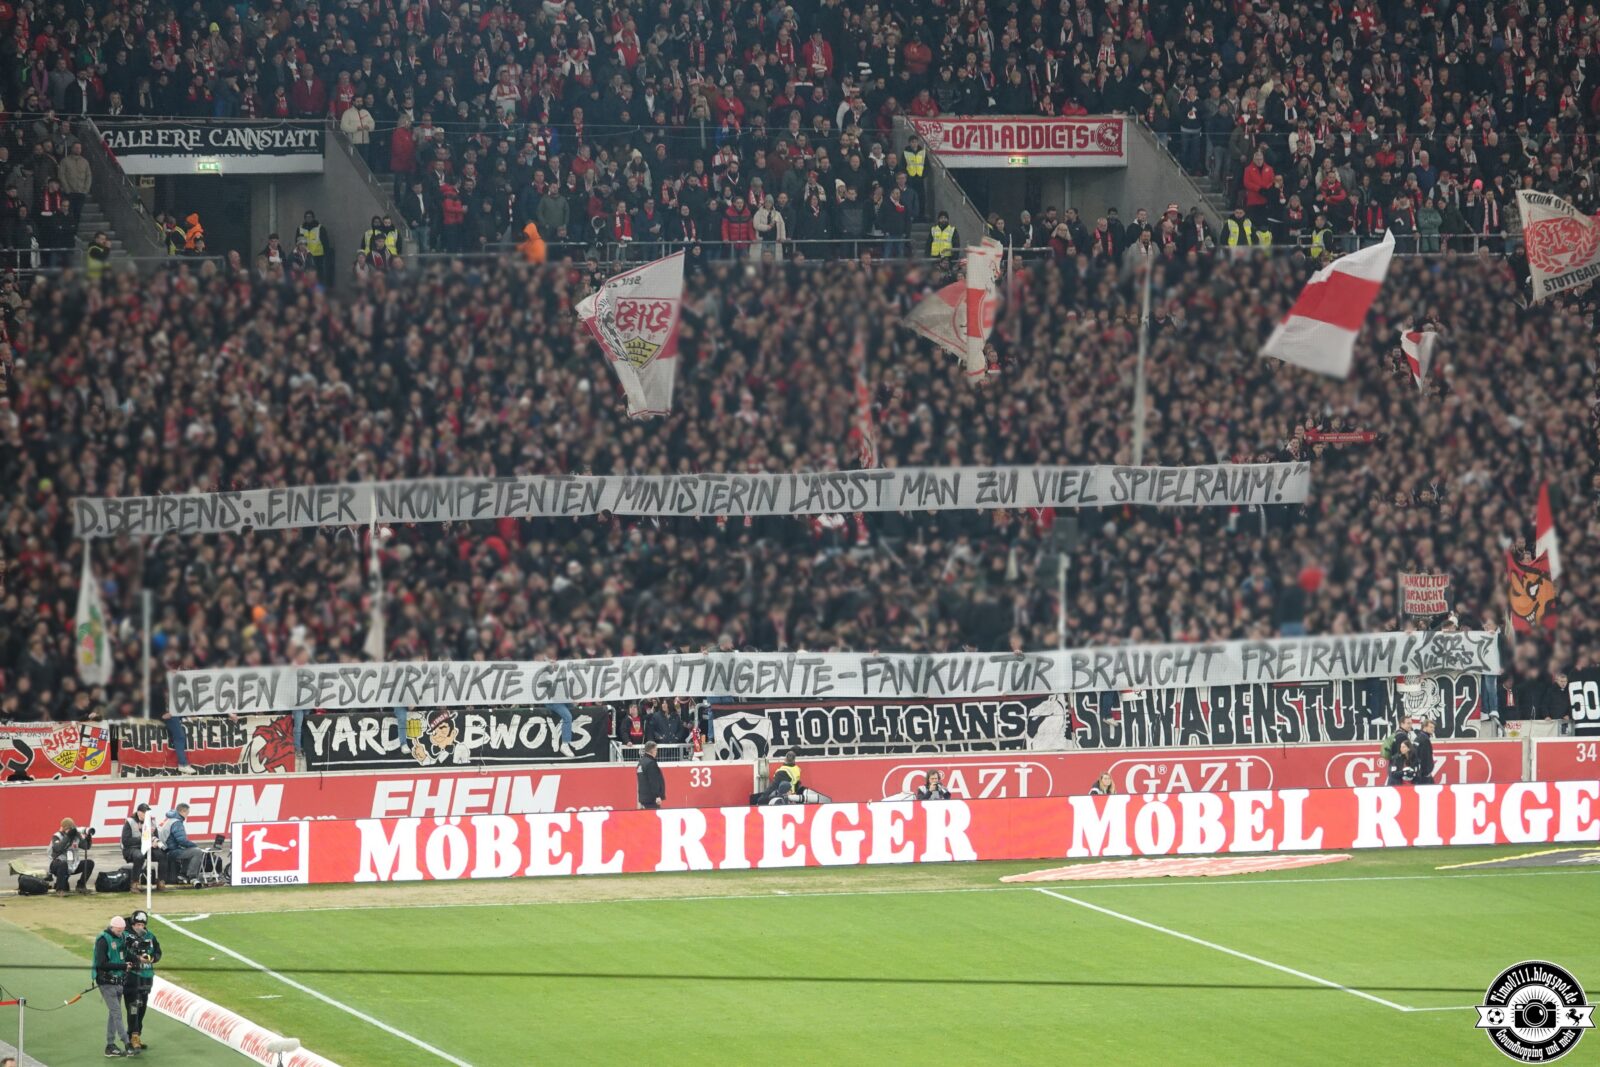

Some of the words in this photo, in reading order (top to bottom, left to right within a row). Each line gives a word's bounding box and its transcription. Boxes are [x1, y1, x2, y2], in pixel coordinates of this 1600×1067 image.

[100, 129, 204, 150] GALEERE
[208, 128, 319, 151] CANNSTATT
[374, 476, 605, 519] NKOMPETENTEN
[613, 474, 781, 514] MINISTERIN
[900, 471, 961, 506] MAN
[976, 469, 1019, 504] ZU
[1032, 468, 1098, 503] VIEL
[171, 670, 280, 713] GEGEN
[295, 663, 525, 707] BESCHRÄNKTE
[1070, 645, 1226, 690] BRAUCHT
[1241, 636, 1417, 680] FREIRAUM!
[306, 716, 400, 756] YARD
[463, 714, 593, 753] BWOYS
[766, 701, 1028, 746] HOOLIGANS
[1576, 743, 1598, 762] 34
[370, 774, 562, 818] EHEIM
[690, 767, 712, 787] 33
[90, 784, 285, 838] EHEIM
[1067, 788, 1324, 858] MÖBEL
[353, 808, 625, 882] MÖBEL
[654, 799, 977, 872] RIEGER
[240, 875, 299, 884] BUNDESLIGA
